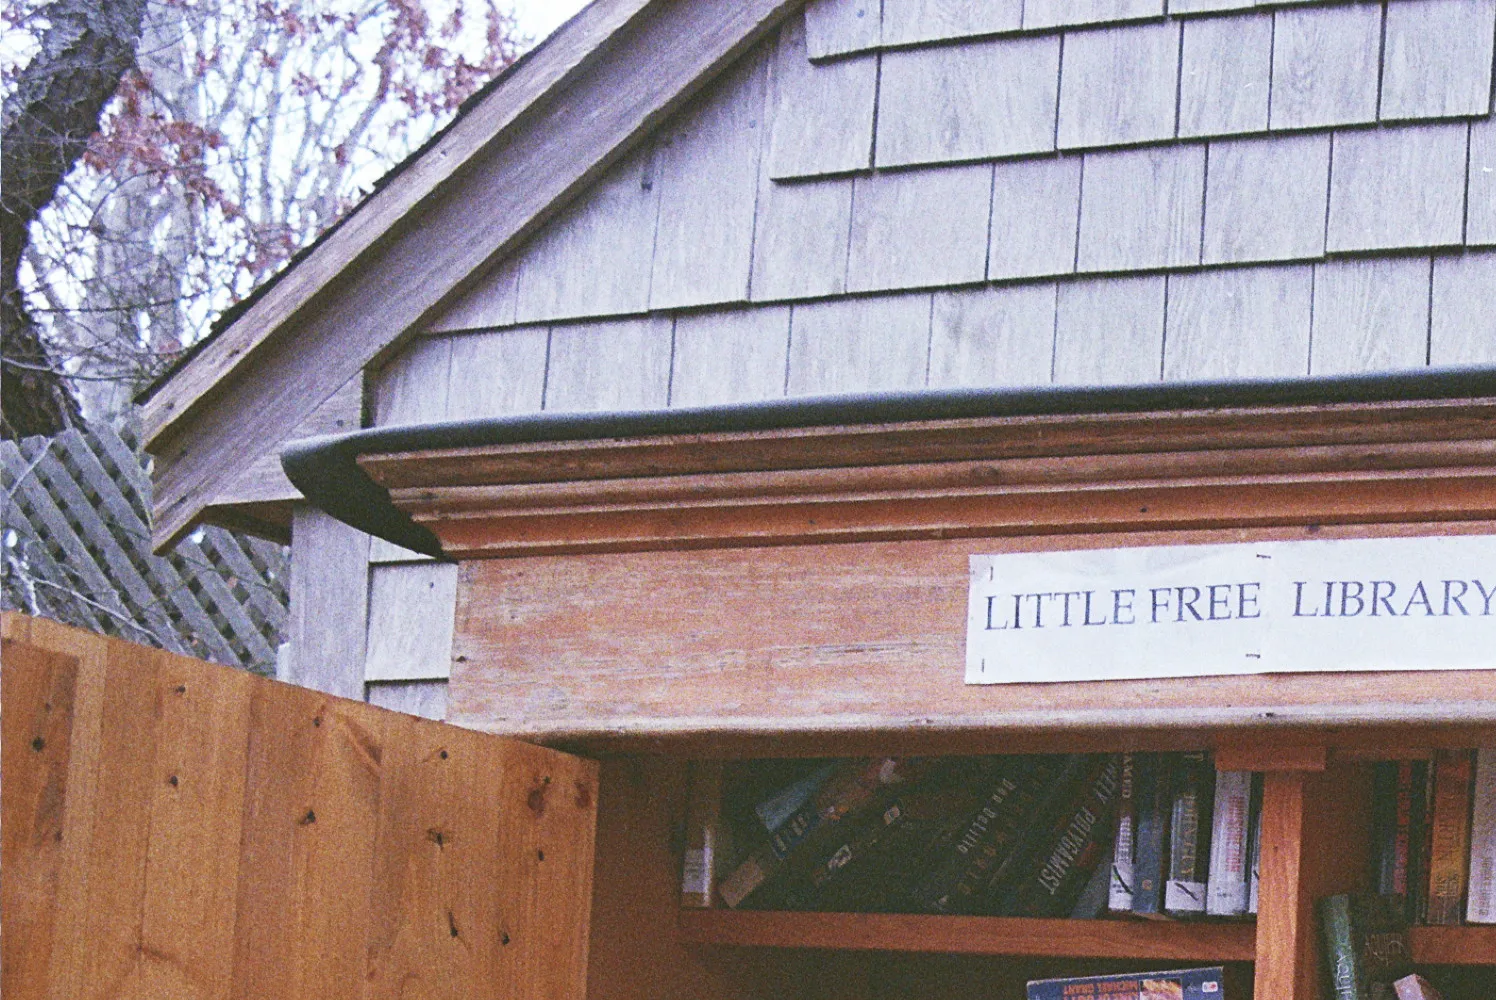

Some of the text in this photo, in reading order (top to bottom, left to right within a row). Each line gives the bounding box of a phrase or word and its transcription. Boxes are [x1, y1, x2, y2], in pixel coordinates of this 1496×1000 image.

[984, 588, 1136, 630] LITTLE
[1150, 582, 1262, 621] FREE
[956, 807, 998, 855] DeLillo
[1039, 806, 1097, 896] POLYGAMIST
